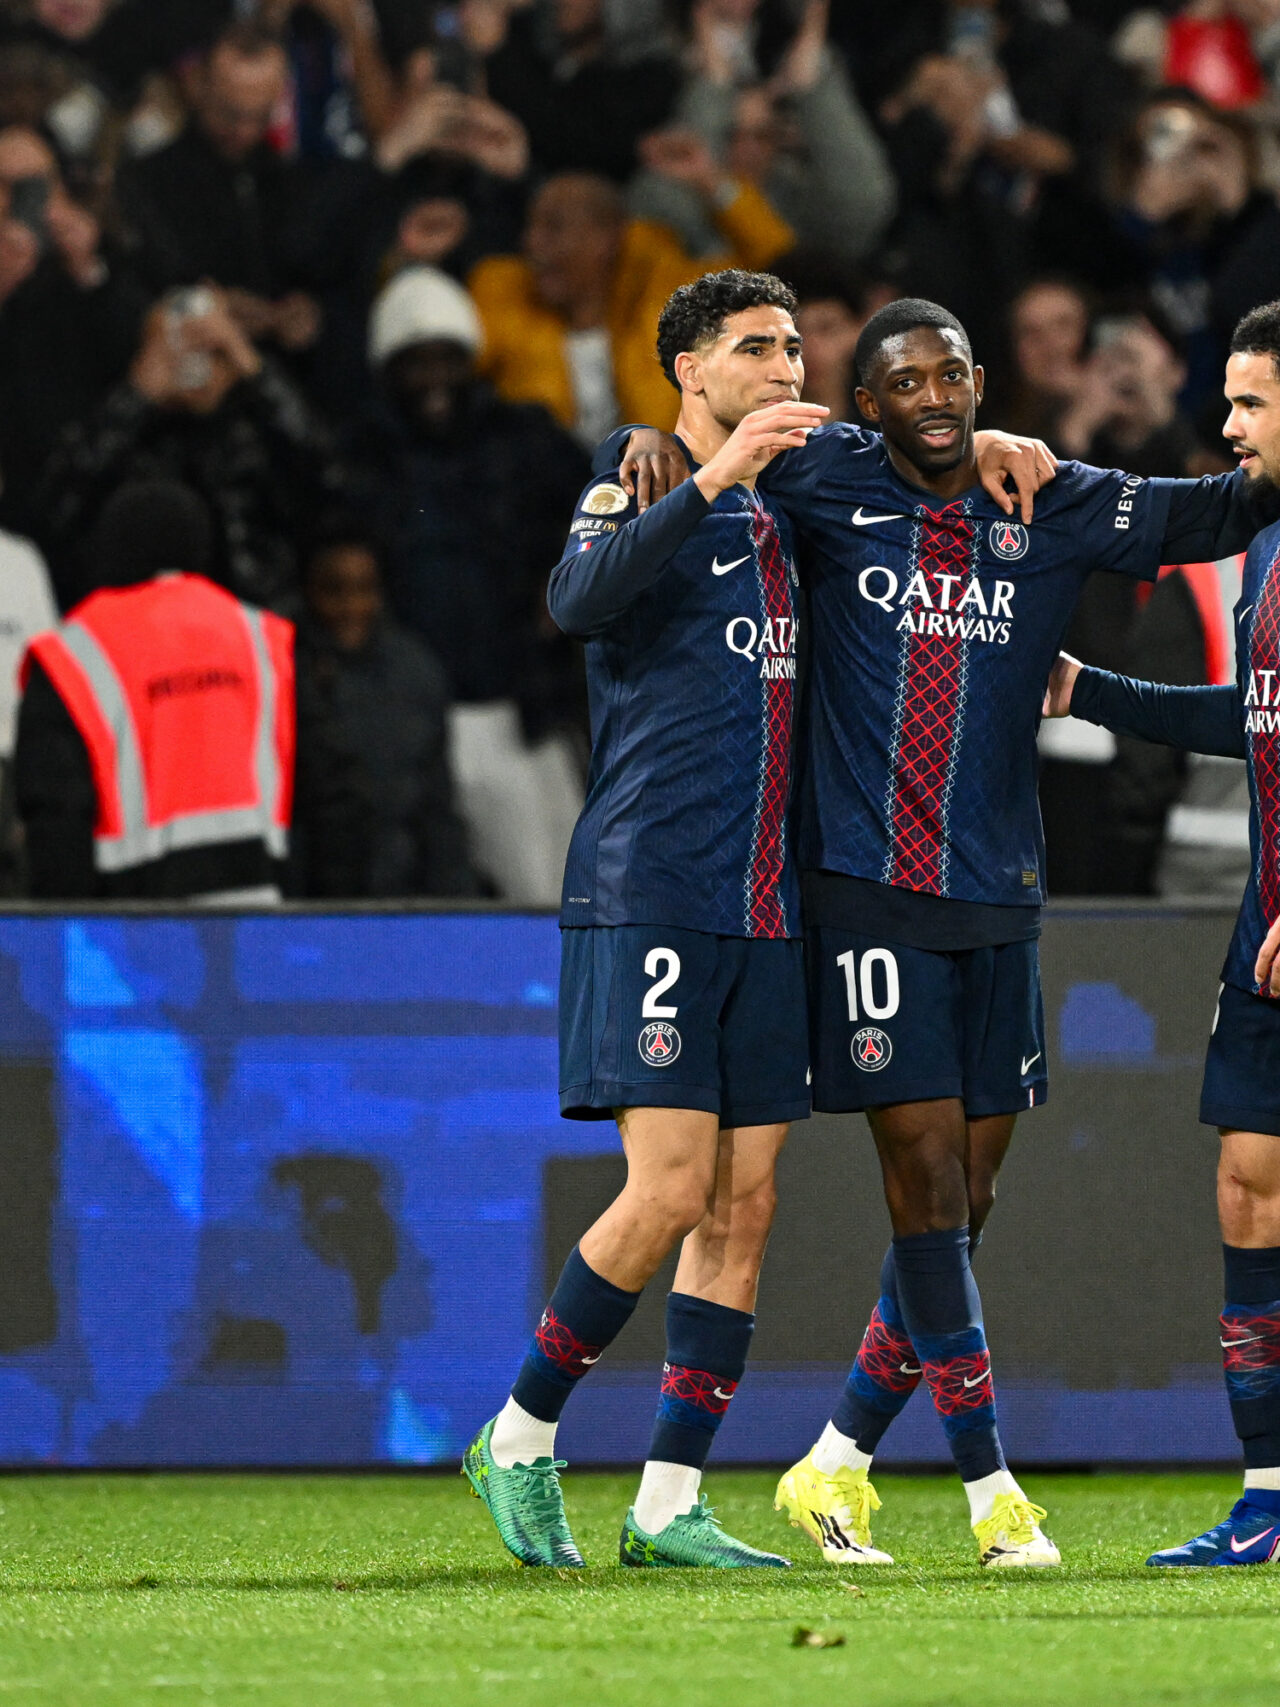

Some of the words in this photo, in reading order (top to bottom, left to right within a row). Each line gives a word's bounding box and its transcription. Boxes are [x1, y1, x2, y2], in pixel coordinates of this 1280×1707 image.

[858, 566, 1015, 619] QATAR
[725, 616, 799, 663] QATA
[896, 609, 1013, 645] AIRWAYS
[641, 947, 681, 1019] 2
[836, 947, 900, 1022] 10
[645, 1024, 674, 1036] PARIS
[856, 1029, 883, 1042] PARIS
